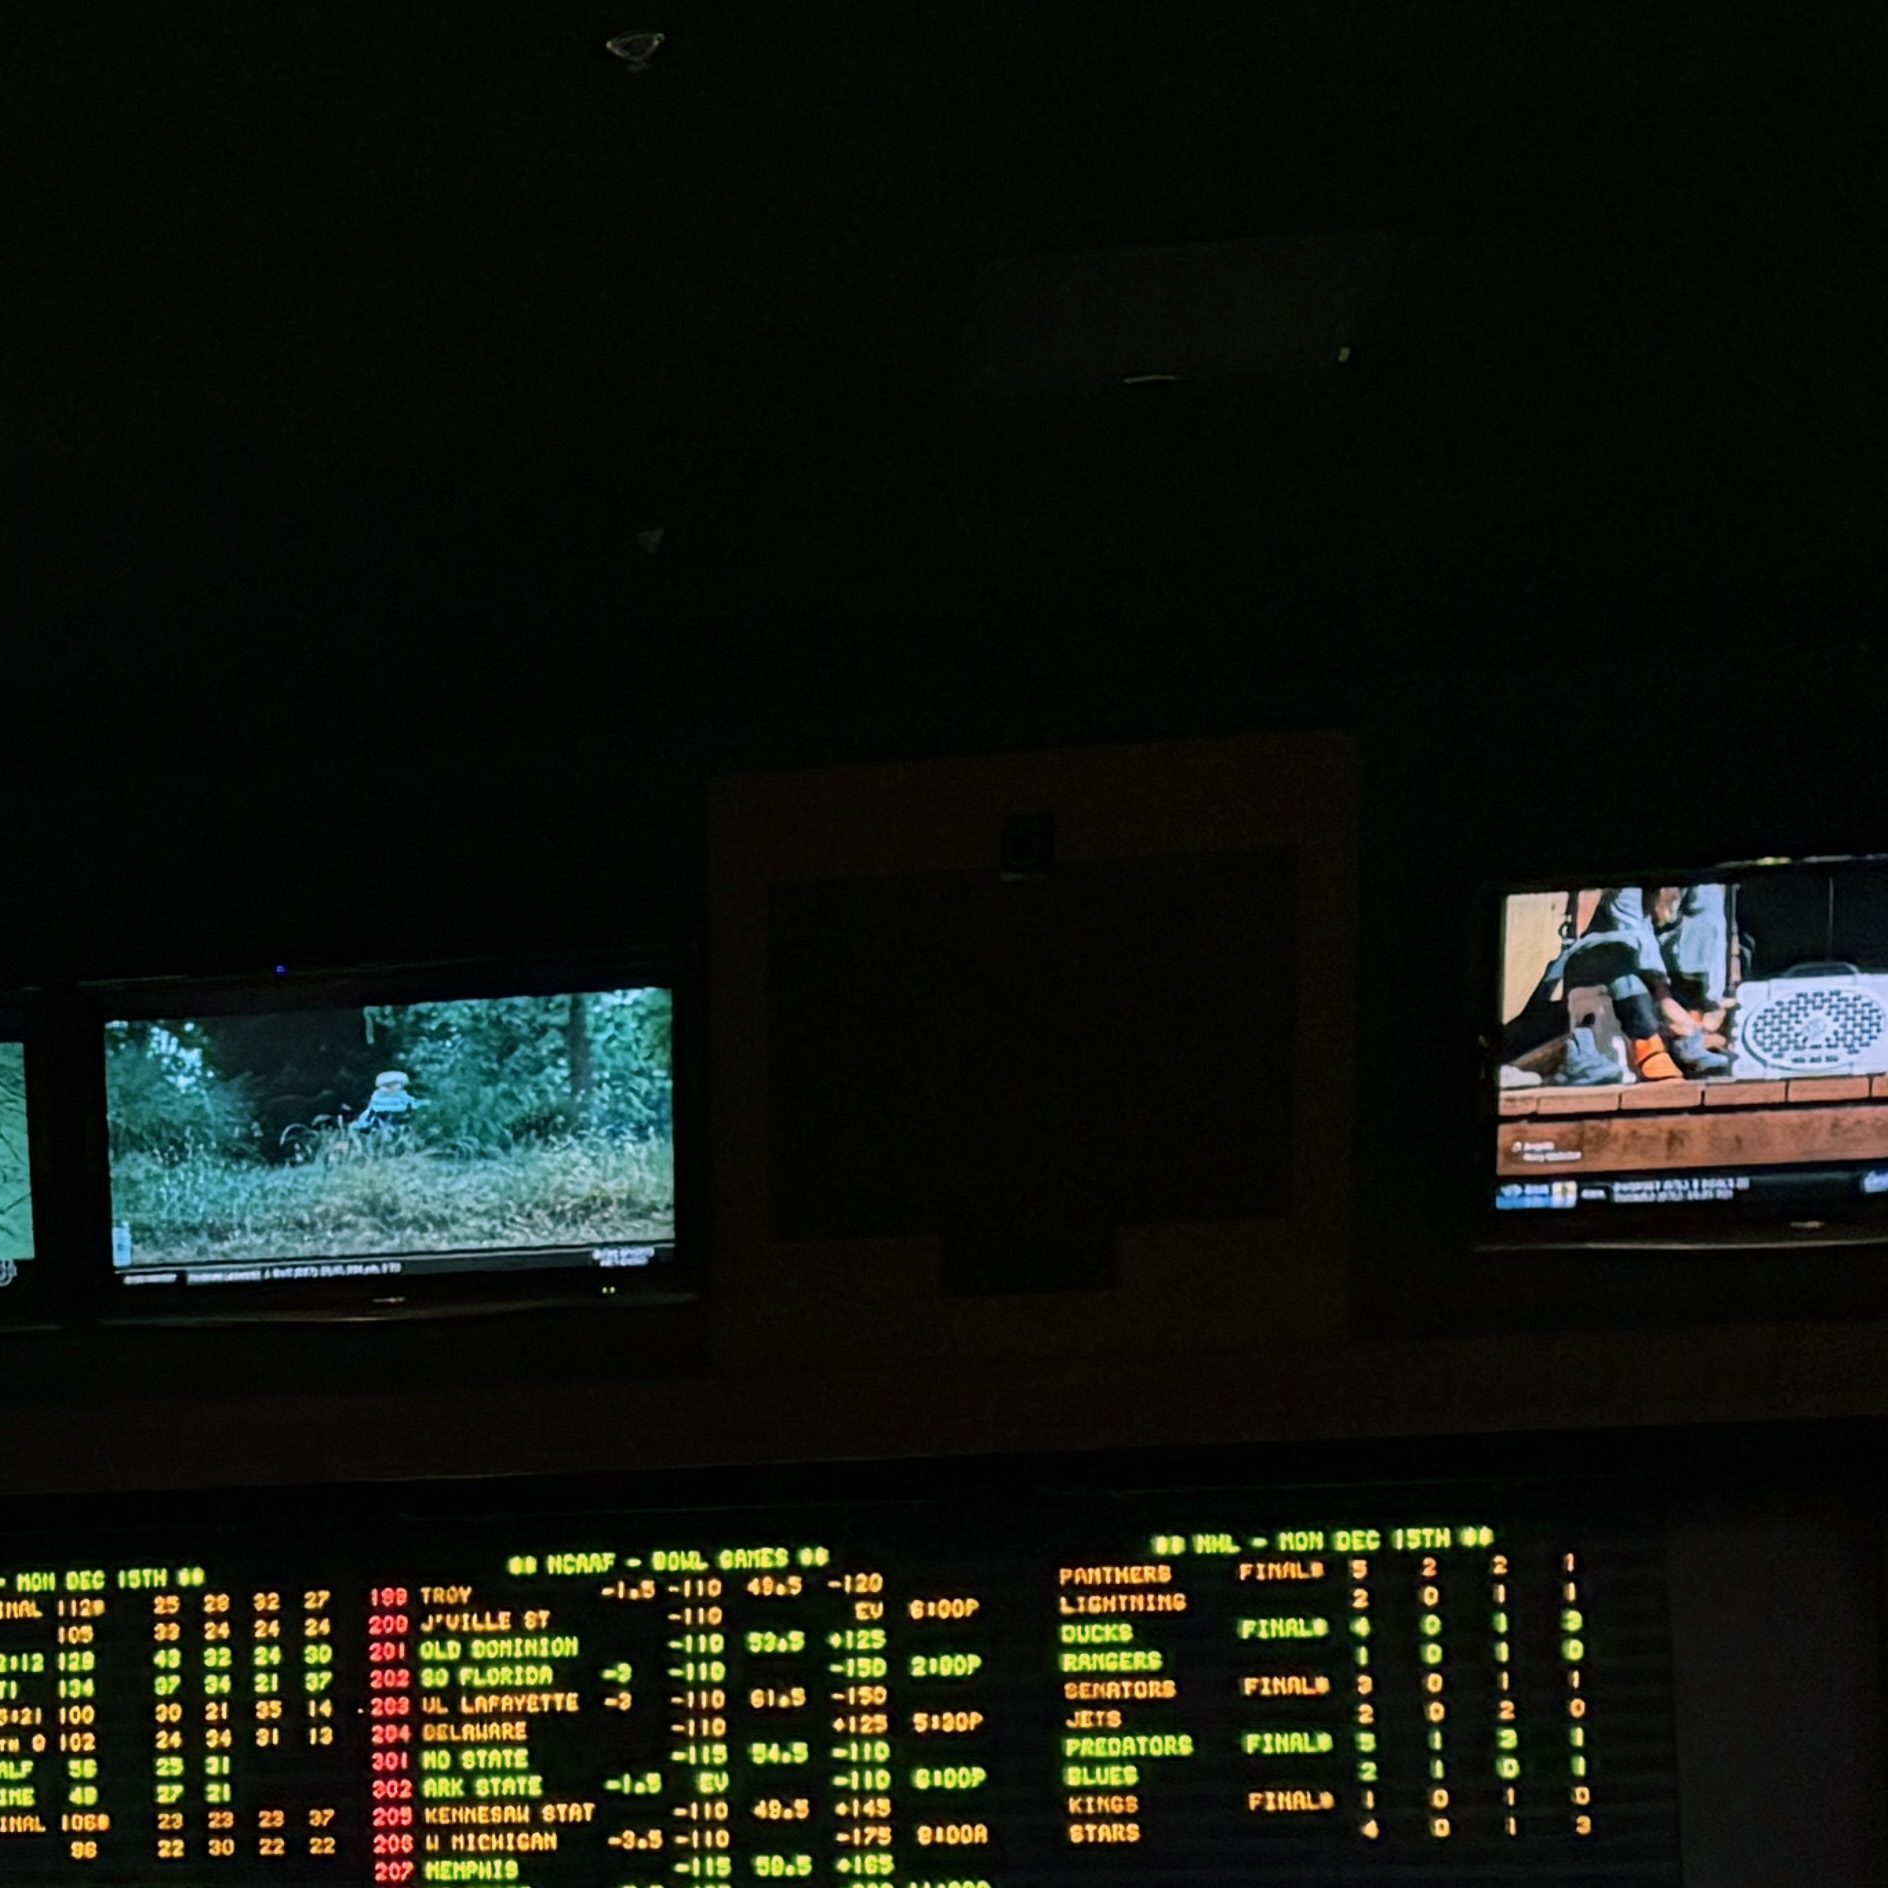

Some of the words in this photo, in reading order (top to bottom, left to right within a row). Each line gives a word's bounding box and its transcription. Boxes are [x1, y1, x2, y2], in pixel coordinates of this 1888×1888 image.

[1277, 1531, 1324, 1551] MON
[1332, 1530, 1380, 1552] DEC
[1392, 1528, 1451, 1550] 15TH
[651, 1551, 709, 1571] BOWL
[717, 1547, 789, 1570] GAMES
[16, 1572, 55, 1592] MON
[65, 1570, 105, 1591] DEC
[118, 1568, 167, 1589] 15TH
[1060, 1565, 1172, 1585] PANTHERS
[420, 1586, 472, 1604] TROY
[1060, 1593, 1186, 1614] LIGHTNING
[1060, 1623, 1133, 1644] DUCKS
[419, 1640, 461, 1661] OLD
[470, 1636, 578, 1659] DOMINION
[1059, 1651, 1163, 1672] RANGERS
[458, 1664, 553, 1687] FLORIDA
[59, 1678, 94, 1698] 134
[1064, 1680, 1176, 1699] SENATORS
[461, 1692, 579, 1714] LAFAYETTE
[60, 1705, 95, 1725] 100
[1066, 1710, 1122, 1728] JETS
[60, 1732, 95, 1752] 102
[422, 1721, 527, 1742] DELAWARE
[1064, 1734, 1194, 1758] PREDATORS
[1064, 1765, 1139, 1786] BLUES
[422, 1776, 465, 1798] ARK
[474, 1775, 542, 1798] STATE
[425, 1805, 530, 1824] KENNESAW
[541, 1803, 595, 1823] STAT
[1068, 1795, 1138, 1814] KINGS
[451, 1832, 557, 1852] MICHIGAN
[1069, 1823, 1140, 1843] STARS
[424, 1859, 518, 1881] MEMPHIS
